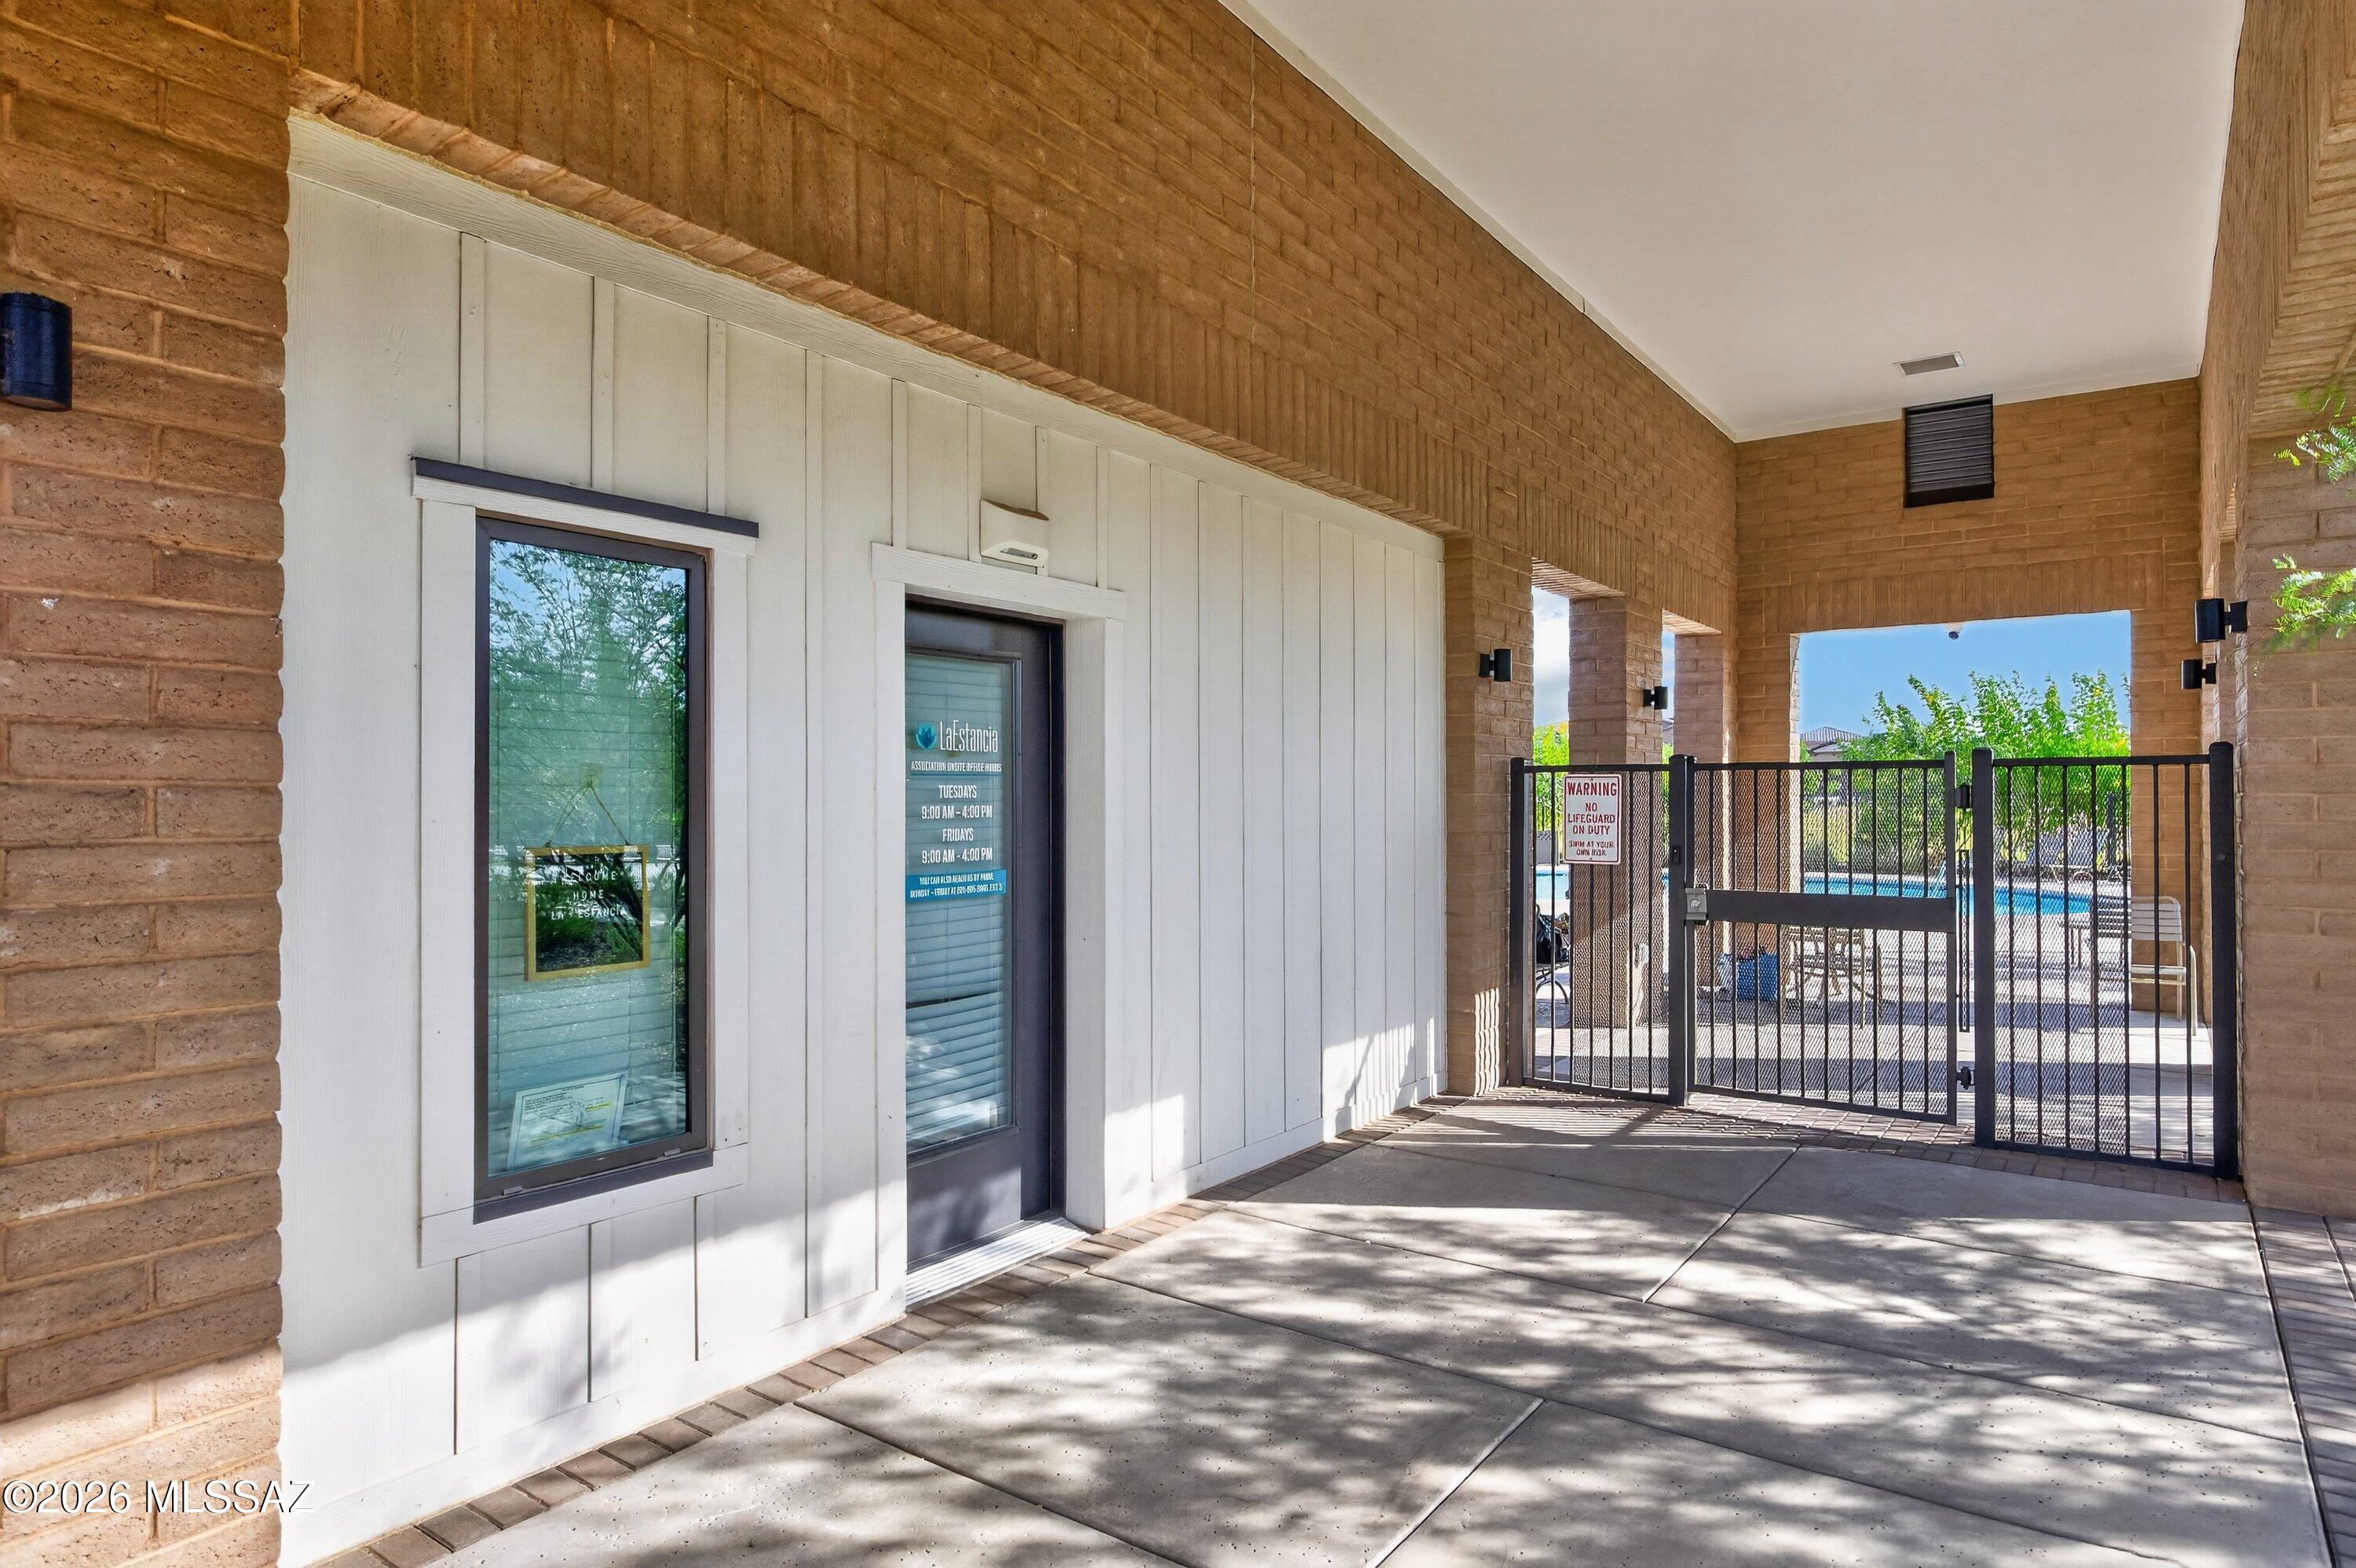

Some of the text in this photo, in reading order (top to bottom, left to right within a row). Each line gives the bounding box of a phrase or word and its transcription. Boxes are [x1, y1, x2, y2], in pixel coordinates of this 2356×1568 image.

[940, 719, 998, 752] LaEstancia
[938, 784, 977, 799] TUESDAYS
[1568, 782, 1617, 796] WARNING
[921, 806, 940, 820] 9:00
[942, 805, 955, 819] AM
[962, 805, 980, 819] 4:00
[981, 805, 993, 818] PM
[1585, 802, 1597, 812] NO
[1568, 813, 1615, 824] LIFEGUARD
[942, 828, 974, 842] FRIDAYS
[1573, 825, 1611, 835] ON DUTY
[922, 850, 941, 864] 9:00
[942, 849, 955, 862] AM
[961, 848, 980, 862] 4:00
[981, 846, 993, 861] PM
[573, 889, 604, 901] HOME
